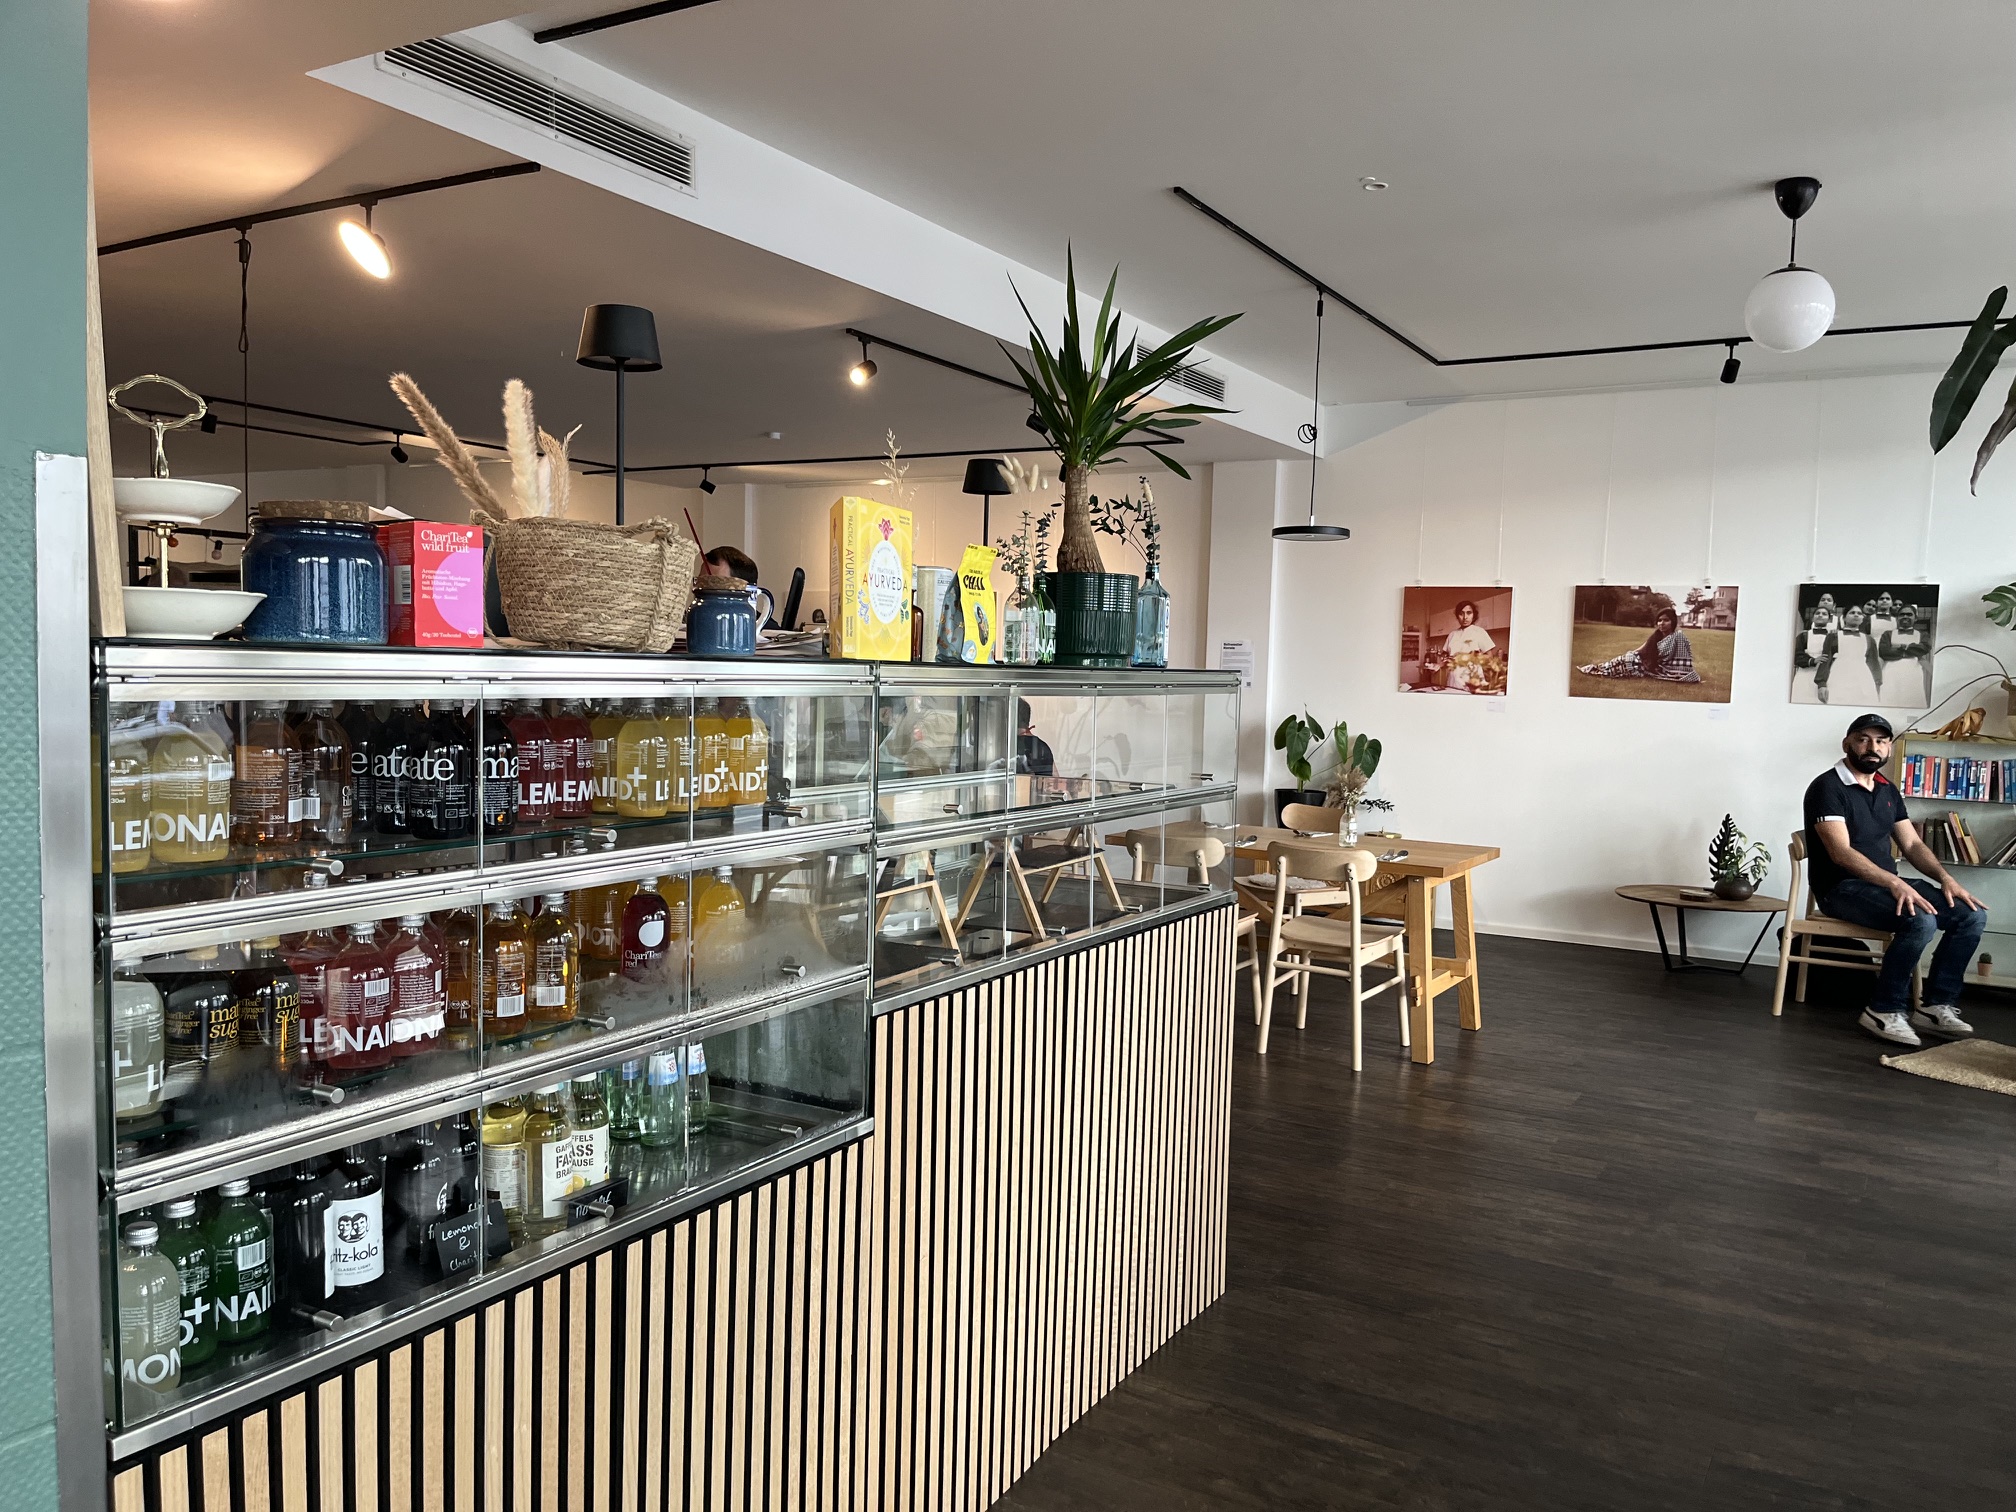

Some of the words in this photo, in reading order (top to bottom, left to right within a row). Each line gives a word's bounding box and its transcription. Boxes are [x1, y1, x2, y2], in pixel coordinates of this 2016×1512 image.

[421, 530, 468, 543] ChariTea
[422, 541, 444, 552] wild
[446, 542, 469, 553] fruit
[845, 549, 855, 604] AYURVEDA
[862, 573, 908, 592] AYURVEDA
[624, 949, 663, 960] ChariTea
[625, 959, 638, 968] red
[571, 1158, 594, 1168] AUSE
[458, 1235, 471, 1251] &
